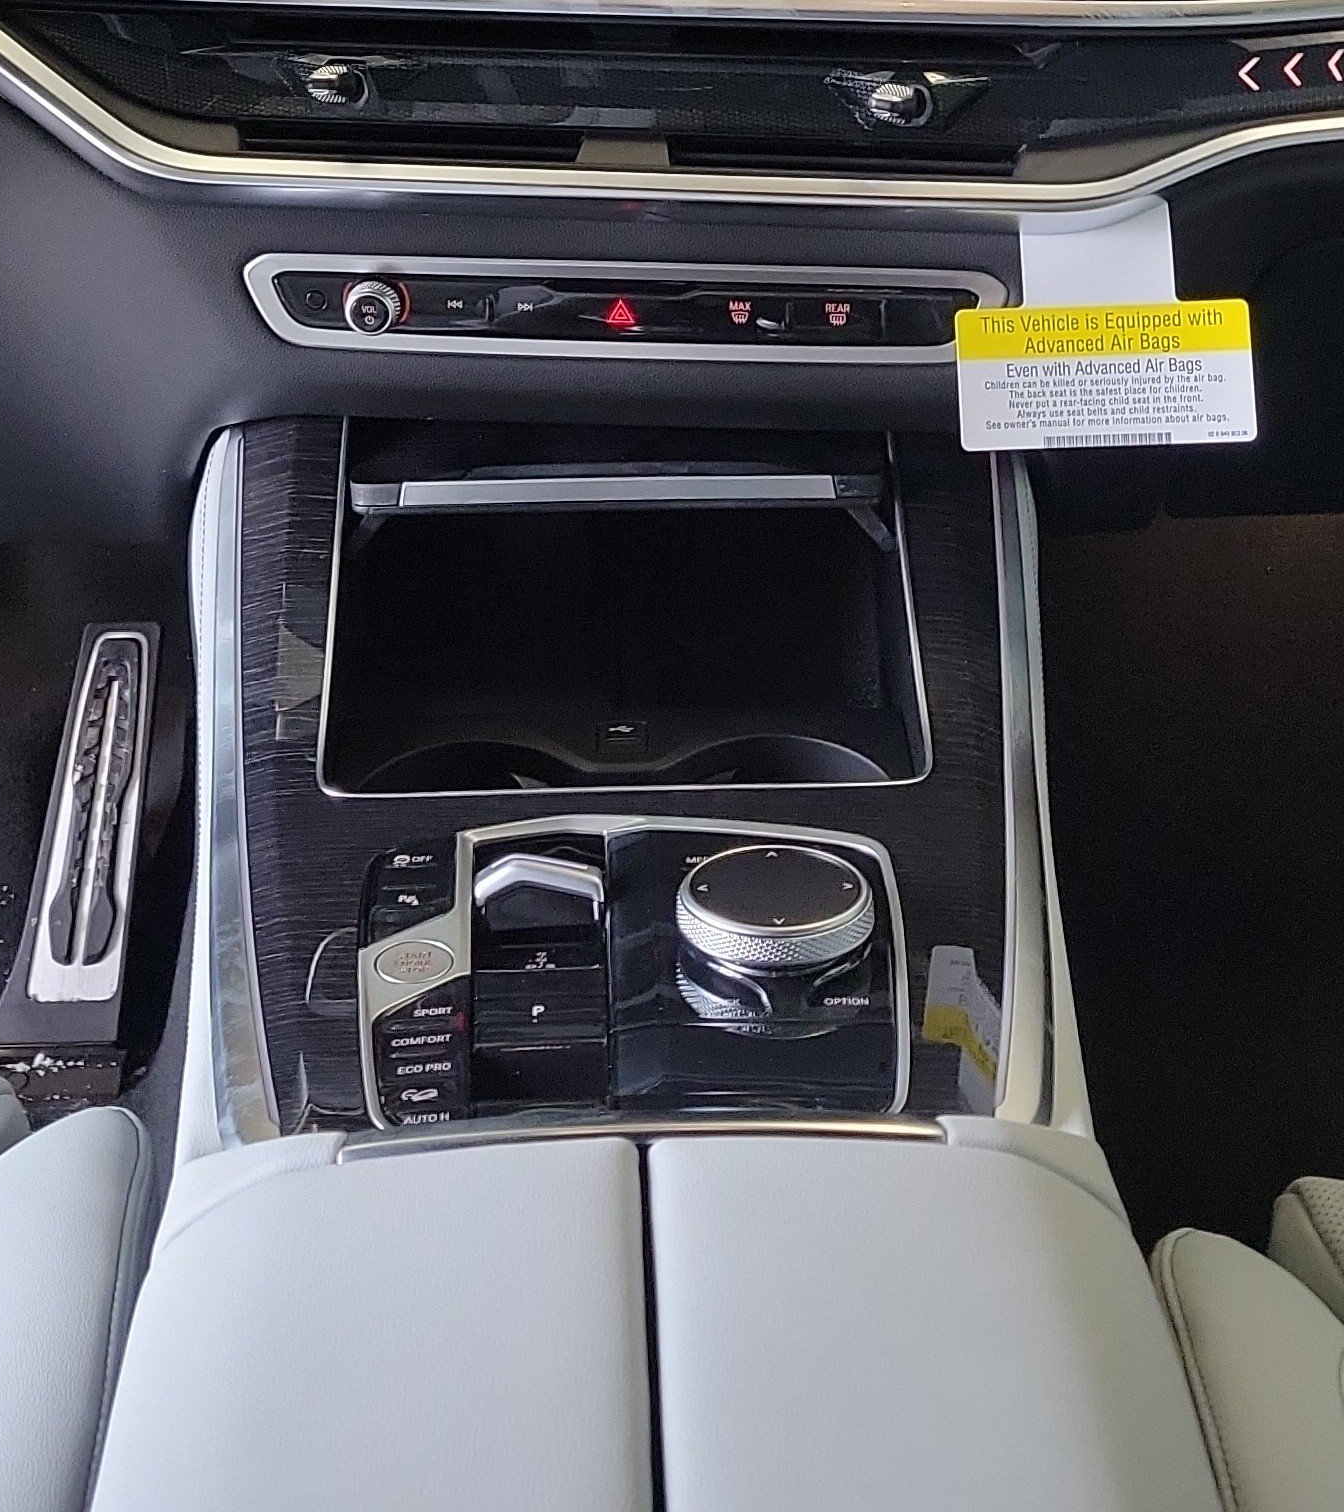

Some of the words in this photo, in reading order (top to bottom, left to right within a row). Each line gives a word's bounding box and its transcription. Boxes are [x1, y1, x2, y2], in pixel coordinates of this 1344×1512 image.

[361, 304, 377, 314] VOL
[729, 300, 752, 312] MAX
[825, 302, 851, 314] REAR
[981, 315, 1015, 334] This
[1020, 314, 1079, 333] Vehicle
[1085, 313, 1099, 331] is
[1105, 310, 1182, 332] Equipped
[1188, 308, 1223, 326] with
[1024, 334, 1105, 354] Advanced
[1110, 333, 1134, 351] Air
[1140, 332, 1181, 352] Bags
[1006, 363, 1038, 378] Even
[1042, 361, 1071, 377] with
[1075, 359, 1141, 376] Advanced
[1145, 358, 1164, 374] Air
[1169, 357, 1203, 374] Bags
[984, 380, 1020, 391] Children
[1022, 379, 1038, 388] can
[1040, 379, 1050, 388] be
[1053, 377, 1076, 388] killed
[1078, 379, 1088, 387] or
[1090, 375, 1129, 387] seriously
[1131, 374, 1161, 386] injured
[1164, 374, 1175, 385] by
[1177, 373, 1191, 383] the
[1193, 373, 1206, 382] air
[1207, 373, 1226, 383] bag.
[1009, 390, 1024, 399] The
[1027, 388, 1047, 399] back
[1049, 389, 1067, 398] seat
[1069, 388, 1077, 397] is
[1079, 387, 1094, 397] the
[1096, 386, 1122, 396] safest
[1124, 385, 1147, 397] place
[1149, 385, 1162, 394] for
[1164, 384, 1202, 394] children.
[1009, 399, 1033, 409] Never
[1036, 399, 1050, 409] put
[1052, 399, 1057, 407] a
[1060, 396, 1106, 408] rear-facing
[1108, 395, 1129, 405] child
[1132, 396, 1150, 404] seat
[1153, 394, 1161, 403] in
[1163, 394, 1177, 403] the
[1179, 393, 1203, 403] front.
[1017, 409, 1047, 420] Always
[1049, 410, 1064, 418] use
[1067, 408, 1084, 417] seat
[1087, 407, 1107, 416] belts
[1110, 406, 1126, 415] and
[1128, 405, 1150, 415] child
[1152, 404, 1197, 414] restraints.
[986, 420, 1001, 430] See
[1004, 419, 1037, 429] owner's
[1039, 418, 1070, 428] manual
[1073, 418, 1085, 427] for
[1087, 418, 1110, 426] more
[1112, 414, 1162, 426] information
[1165, 415, 1189, 424] about
[1192, 414, 1203, 423] air
[1206, 413, 1230, 424] bags.
[411, 854, 434, 863] OFF
[823, 997, 870, 1006] OPTION
[412, 1006, 454, 1018] SPORT
[531, 1004, 545, 1017] P
[391, 1033, 453, 1048] COMFORT
[396, 1064, 423, 1075] ECO
[425, 1061, 452, 1073] PRO
[402, 1113, 438, 1125] AUTO
